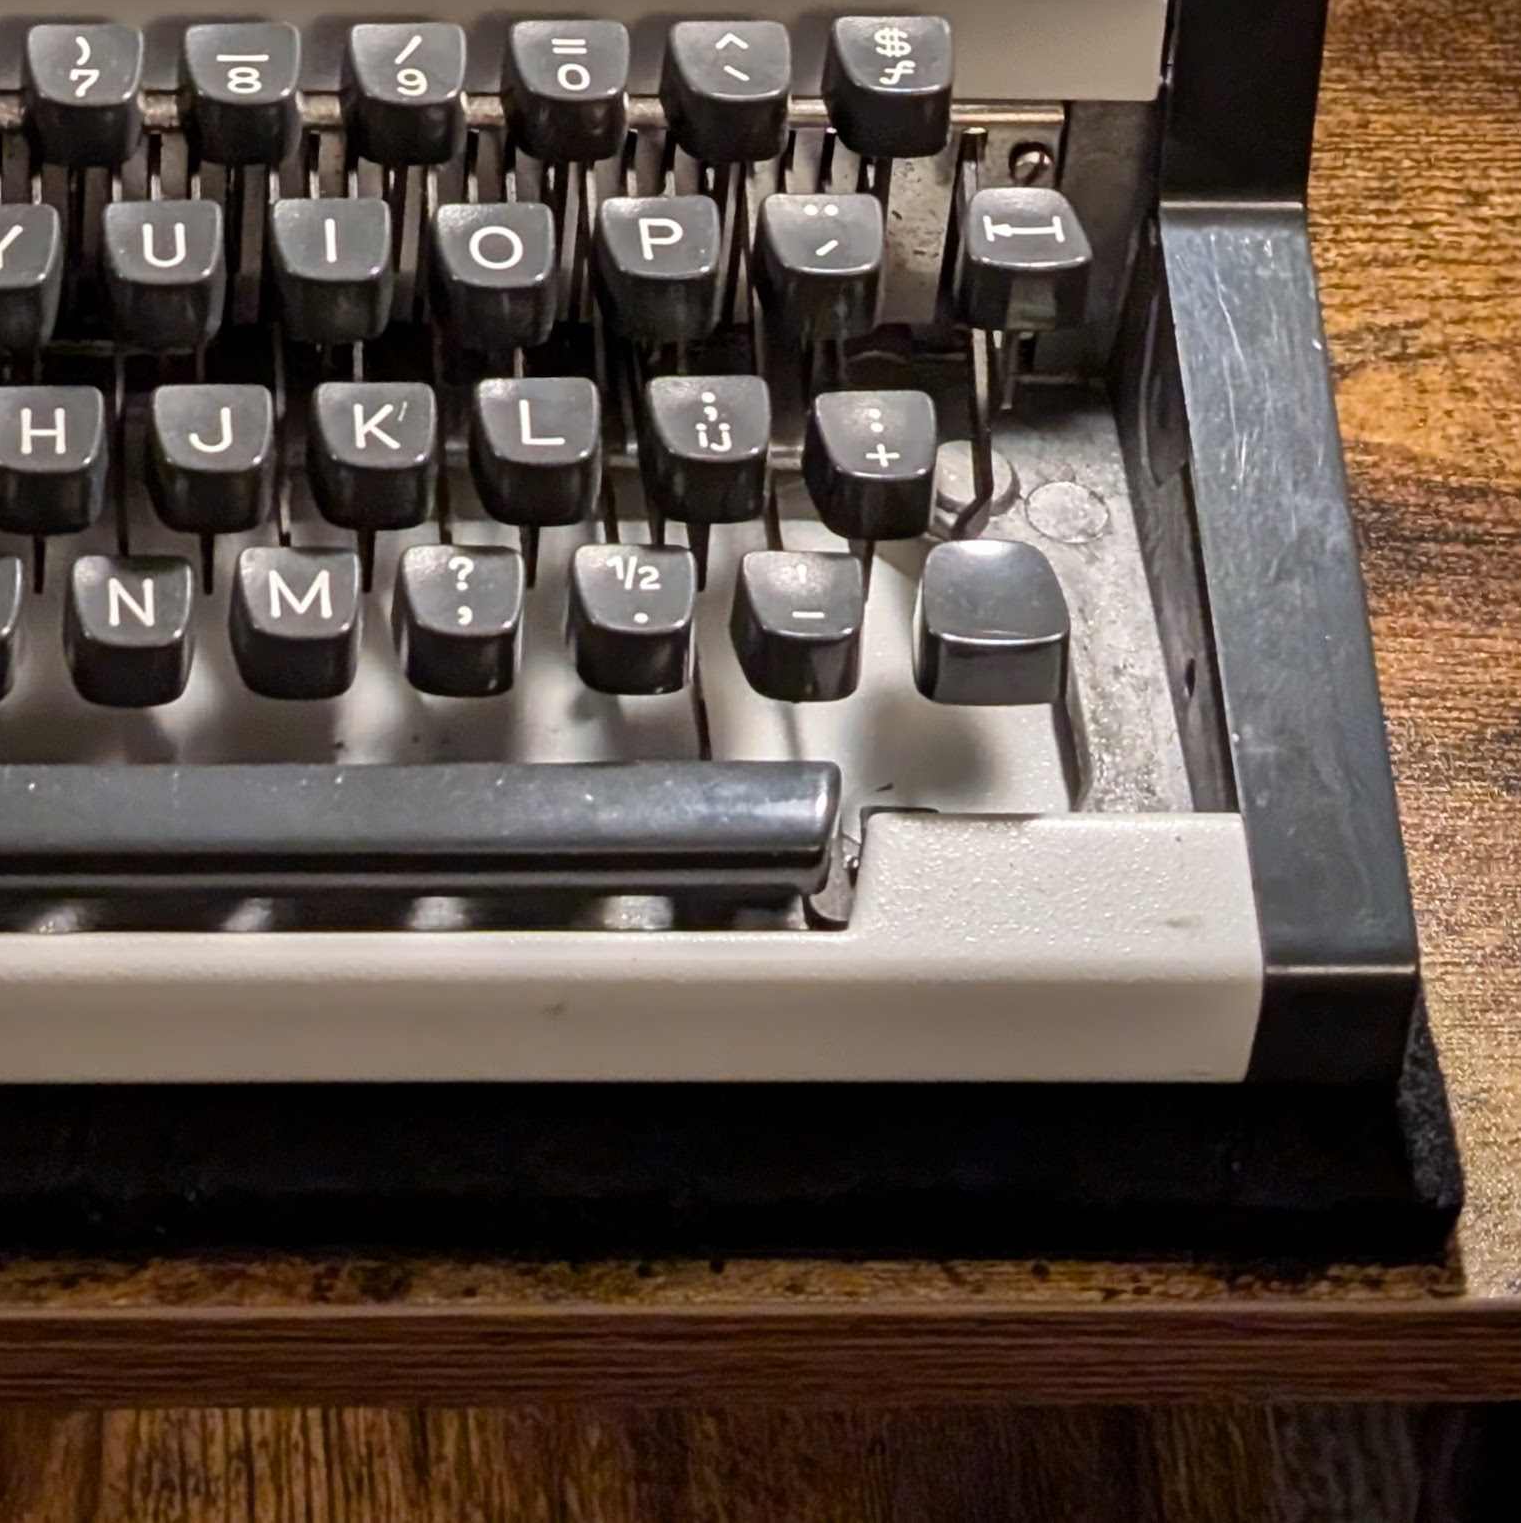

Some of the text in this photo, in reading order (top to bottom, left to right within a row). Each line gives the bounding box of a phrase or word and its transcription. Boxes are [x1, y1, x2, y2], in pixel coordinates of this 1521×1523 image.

[75, 36, 91, 66] )
[551, 38, 588, 55] =
[873, 26, 913, 58] $
[69, 68, 100, 98] 7
[226, 66, 263, 95] 8
[396, 68, 428, 97] 9
[141, 222, 187, 268] U
[324, 218, 338, 263] I
[469, 225, 524, 270] O
[638, 217, 684, 261] P
[353, 403, 401, 450] K
[518, 399, 566, 446] L
[699, 391, 718, 422] ;
[865, 408, 884, 433] :
[20, 407, 67, 455] H
[188, 406, 233, 454] J
[865, 443, 901, 468] +
[267, 568, 333, 619] M
[447, 555, 475, 592] ?
[108, 577, 155, 627] N
